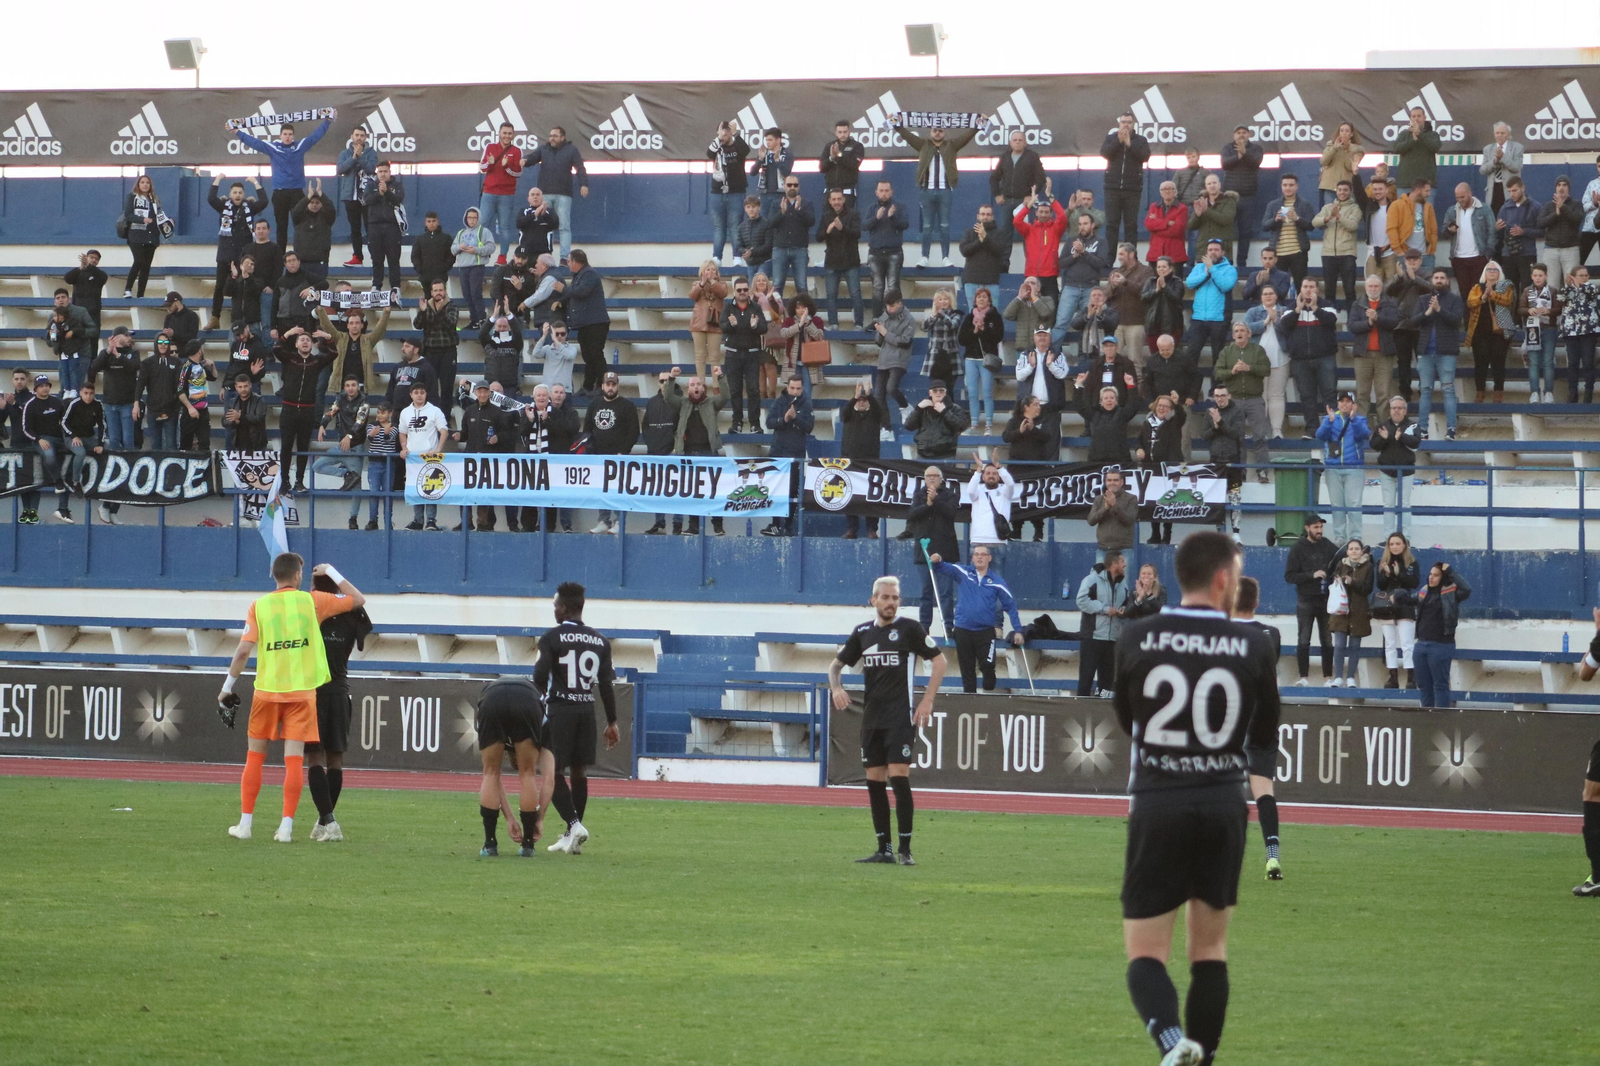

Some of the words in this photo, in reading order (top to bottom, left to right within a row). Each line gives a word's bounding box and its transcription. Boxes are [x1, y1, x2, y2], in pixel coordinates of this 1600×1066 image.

[252, 110, 311, 126] LINENSE
[909, 117, 969, 127] LINENSE
[110, 136, 178, 155] adidas
[467, 131, 538, 150] adas
[590, 130, 663, 150] adidas
[464, 457, 550, 491] BALONA
[565, 467, 591, 486] 1912
[602, 459, 722, 500] PICHIGÜEY
[266, 638, 309, 653] LEGEA
[560, 633, 604, 647] KOROMA
[1139, 631, 1248, 658] J.FORJAN
[558, 649, 600, 690] 19
[863, 654, 900, 667] LOTUS
[45, 685, 73, 739] OF
[82, 686, 122, 741] YOU
[1142, 663, 1242, 750] 20
[361, 695, 389, 750] OF
[400, 696, 441, 753] YOU
[910, 712, 947, 770] ST
[957, 713, 988, 770] OF
[1000, 714, 1045, 773] YOU
[1318, 725, 1351, 784] OF
[1363, 726, 1411, 787] YOU
